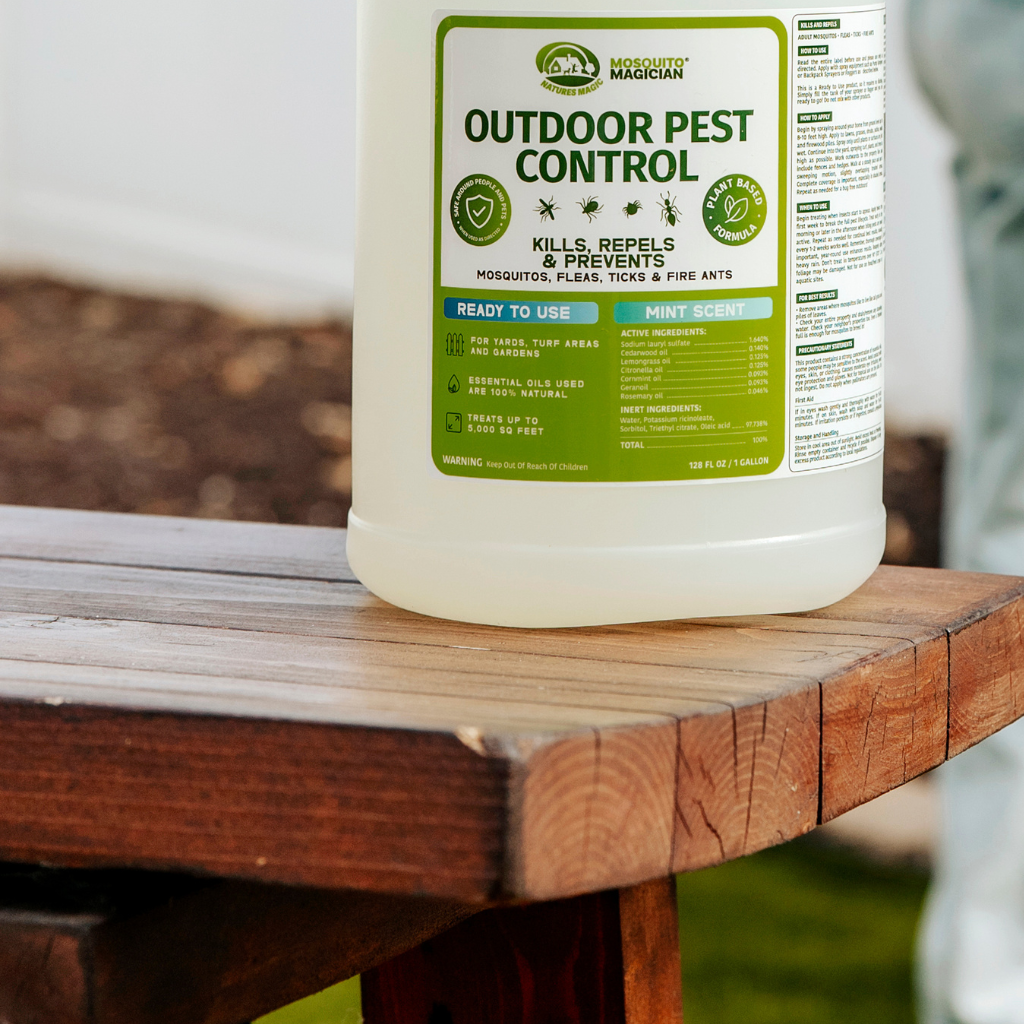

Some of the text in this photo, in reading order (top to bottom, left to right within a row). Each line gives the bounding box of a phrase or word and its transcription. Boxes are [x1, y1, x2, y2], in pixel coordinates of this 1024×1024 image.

[610, 69, 683, 80] MAGICIAN
[540, 78, 604, 96] NATURES MAGIC
[464, 108, 754, 145] OUTDOOR PEST
[515, 149, 699, 183] CONTROL
[456, 180, 474, 201] AROUND
[474, 178, 497, 190] PEOPLE
[494, 189, 505, 202] AND
[706, 177, 763, 209] PLANT BASED
[712, 223, 758, 242] FORMULA
[533, 237, 675, 255] KILLS, REPELS
[542, 254, 665, 268] & PREVENTS
[477, 270, 733, 284] MOSQUITOS, FLEAS, TICKS & FIRE ANTS
[457, 302, 571, 320] READY TO USE
[645, 302, 746, 319] MINT SCENT
[620, 327, 707, 337] ACTIVE INGREDIENTS:
[470, 336, 599, 348] FOR YARDS, TURF AREAS
[620, 340, 645, 348] Sodium
[647, 340, 666, 349] lauryl
[668, 339, 691, 347] sulfate
[470, 347, 540, 358] AND GARDENS
[659, 348, 668, 356] oil
[620, 357, 660, 366] Lemongrass
[620, 366, 653, 374] Citronella
[468, 376, 584, 388] ESSENTIAL OILS USED
[620, 374, 651, 382] Cornmint
[653, 374, 662, 382] oil
[468, 387, 568, 398] ARE 100% NATURAL
[620, 392, 653, 400] Rosemary
[620, 404, 702, 414] INERT INGREDIENTS:
[467, 414, 538, 425] TREATS UP TO
[679, 414, 715, 422] ricinoleate,
[467, 424, 544, 435] 5,000 SQ FEET
[620, 425, 648, 433] Sorbitol,
[650, 425, 674, 433] Triethyl
[620, 441, 645, 449] TOTAL
[442, 454, 588, 471] WARNING Keep Out Of Reach Of Children
[688, 461, 703, 469] 128
[705, 461, 714, 469] FL
[716, 460, 726, 468] OZ
[728, 459, 732, 468] /
[740, 457, 769, 466] GALLON
